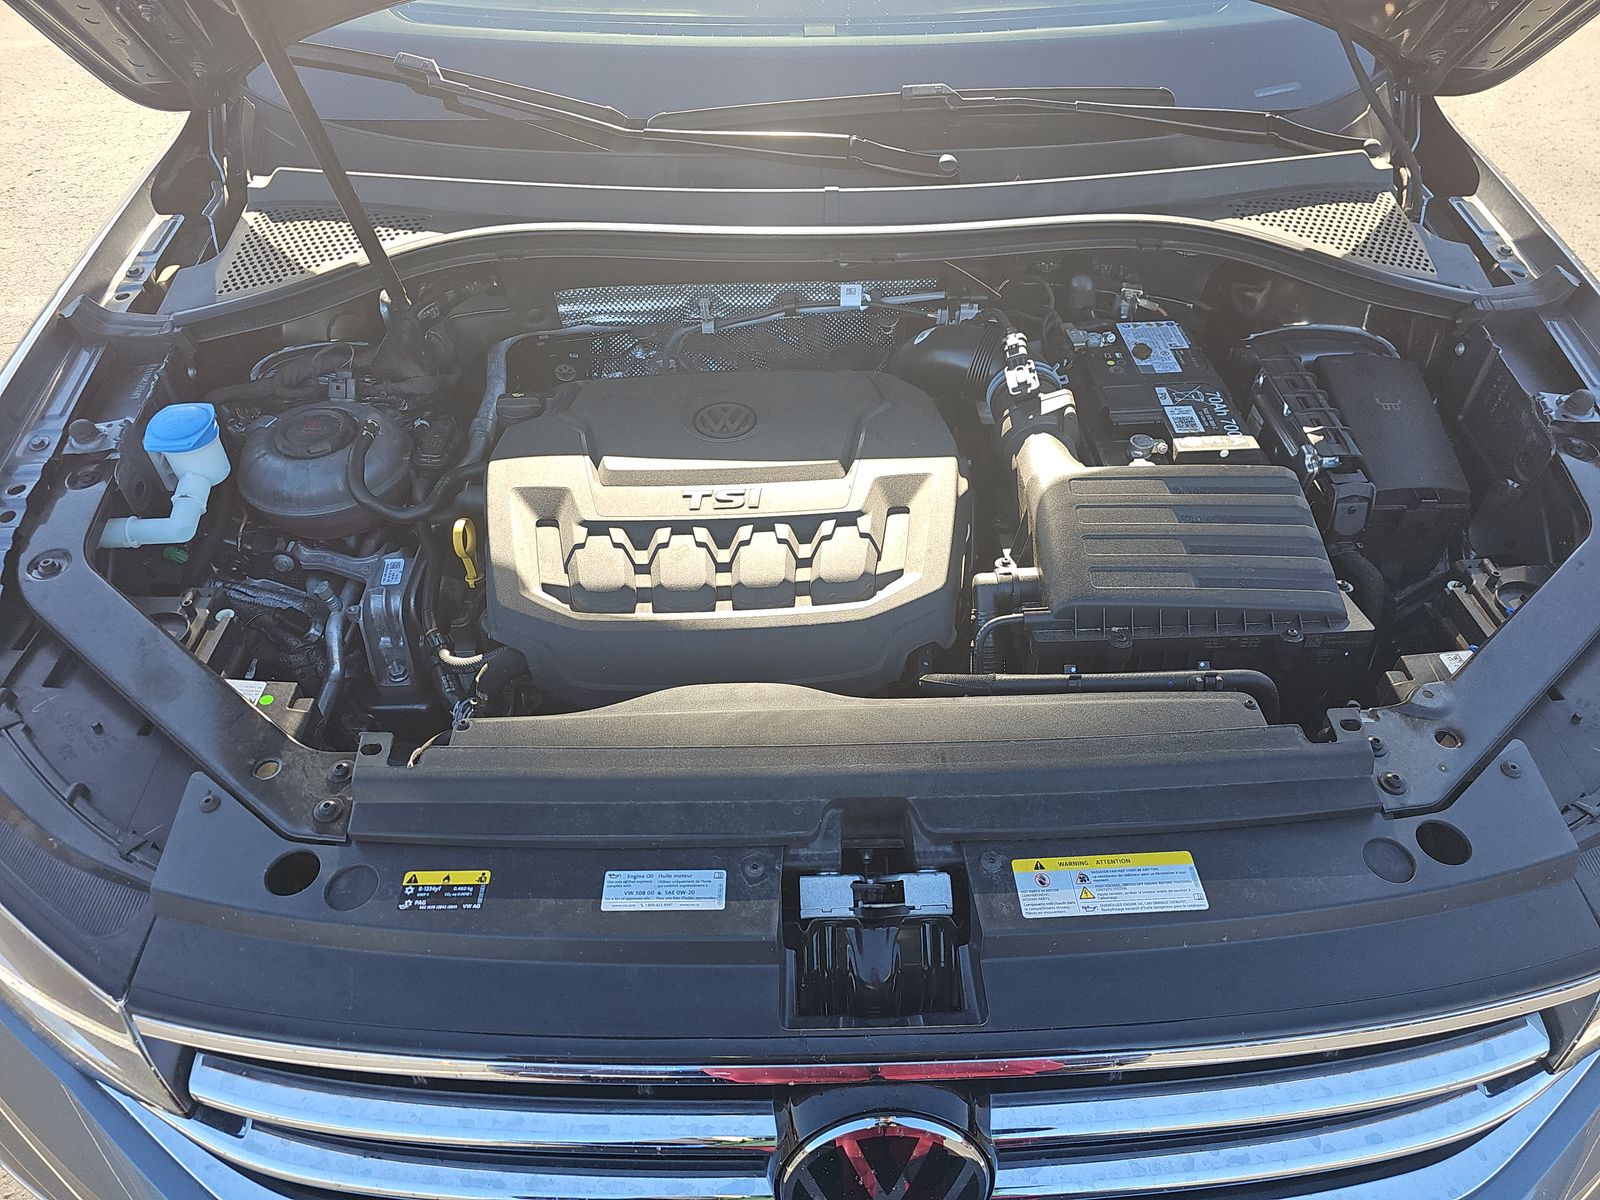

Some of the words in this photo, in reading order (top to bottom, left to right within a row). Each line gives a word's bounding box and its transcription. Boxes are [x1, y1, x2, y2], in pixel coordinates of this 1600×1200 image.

[1205, 391, 1230, 416] 70Ah
[1220, 418, 1243, 437] 700
[682, 488, 762, 511] TSI
[418, 885, 442, 893] R-1234yf
